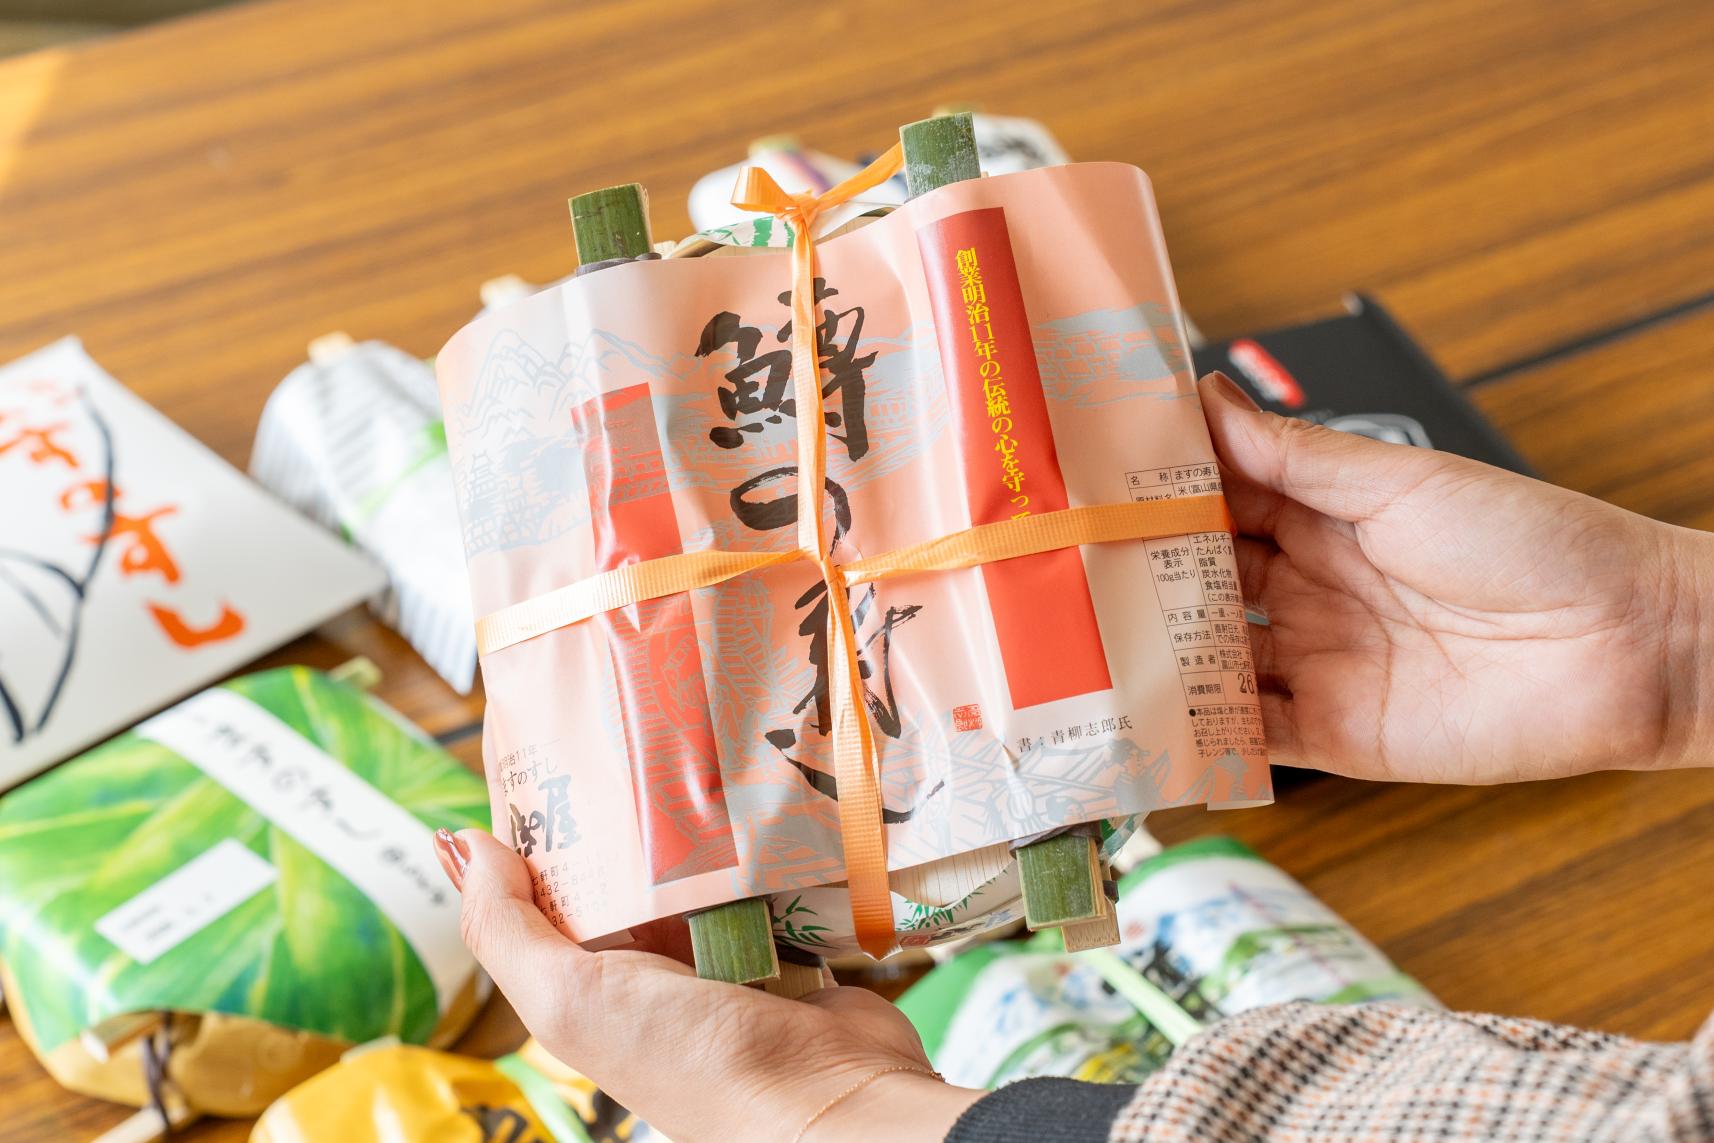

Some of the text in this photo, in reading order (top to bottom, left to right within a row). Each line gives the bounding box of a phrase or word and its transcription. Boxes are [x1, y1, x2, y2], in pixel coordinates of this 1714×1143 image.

[1175, 466, 1220, 481] ますの寿し
[1150, 547, 1191, 560] 栄養成分
[1164, 557, 1184, 569] 表示
[1156, 570, 1196, 583] 100g当たり
[1174, 630, 1212, 644] 保存方法
[1188, 684, 1223, 696] 消費期限
